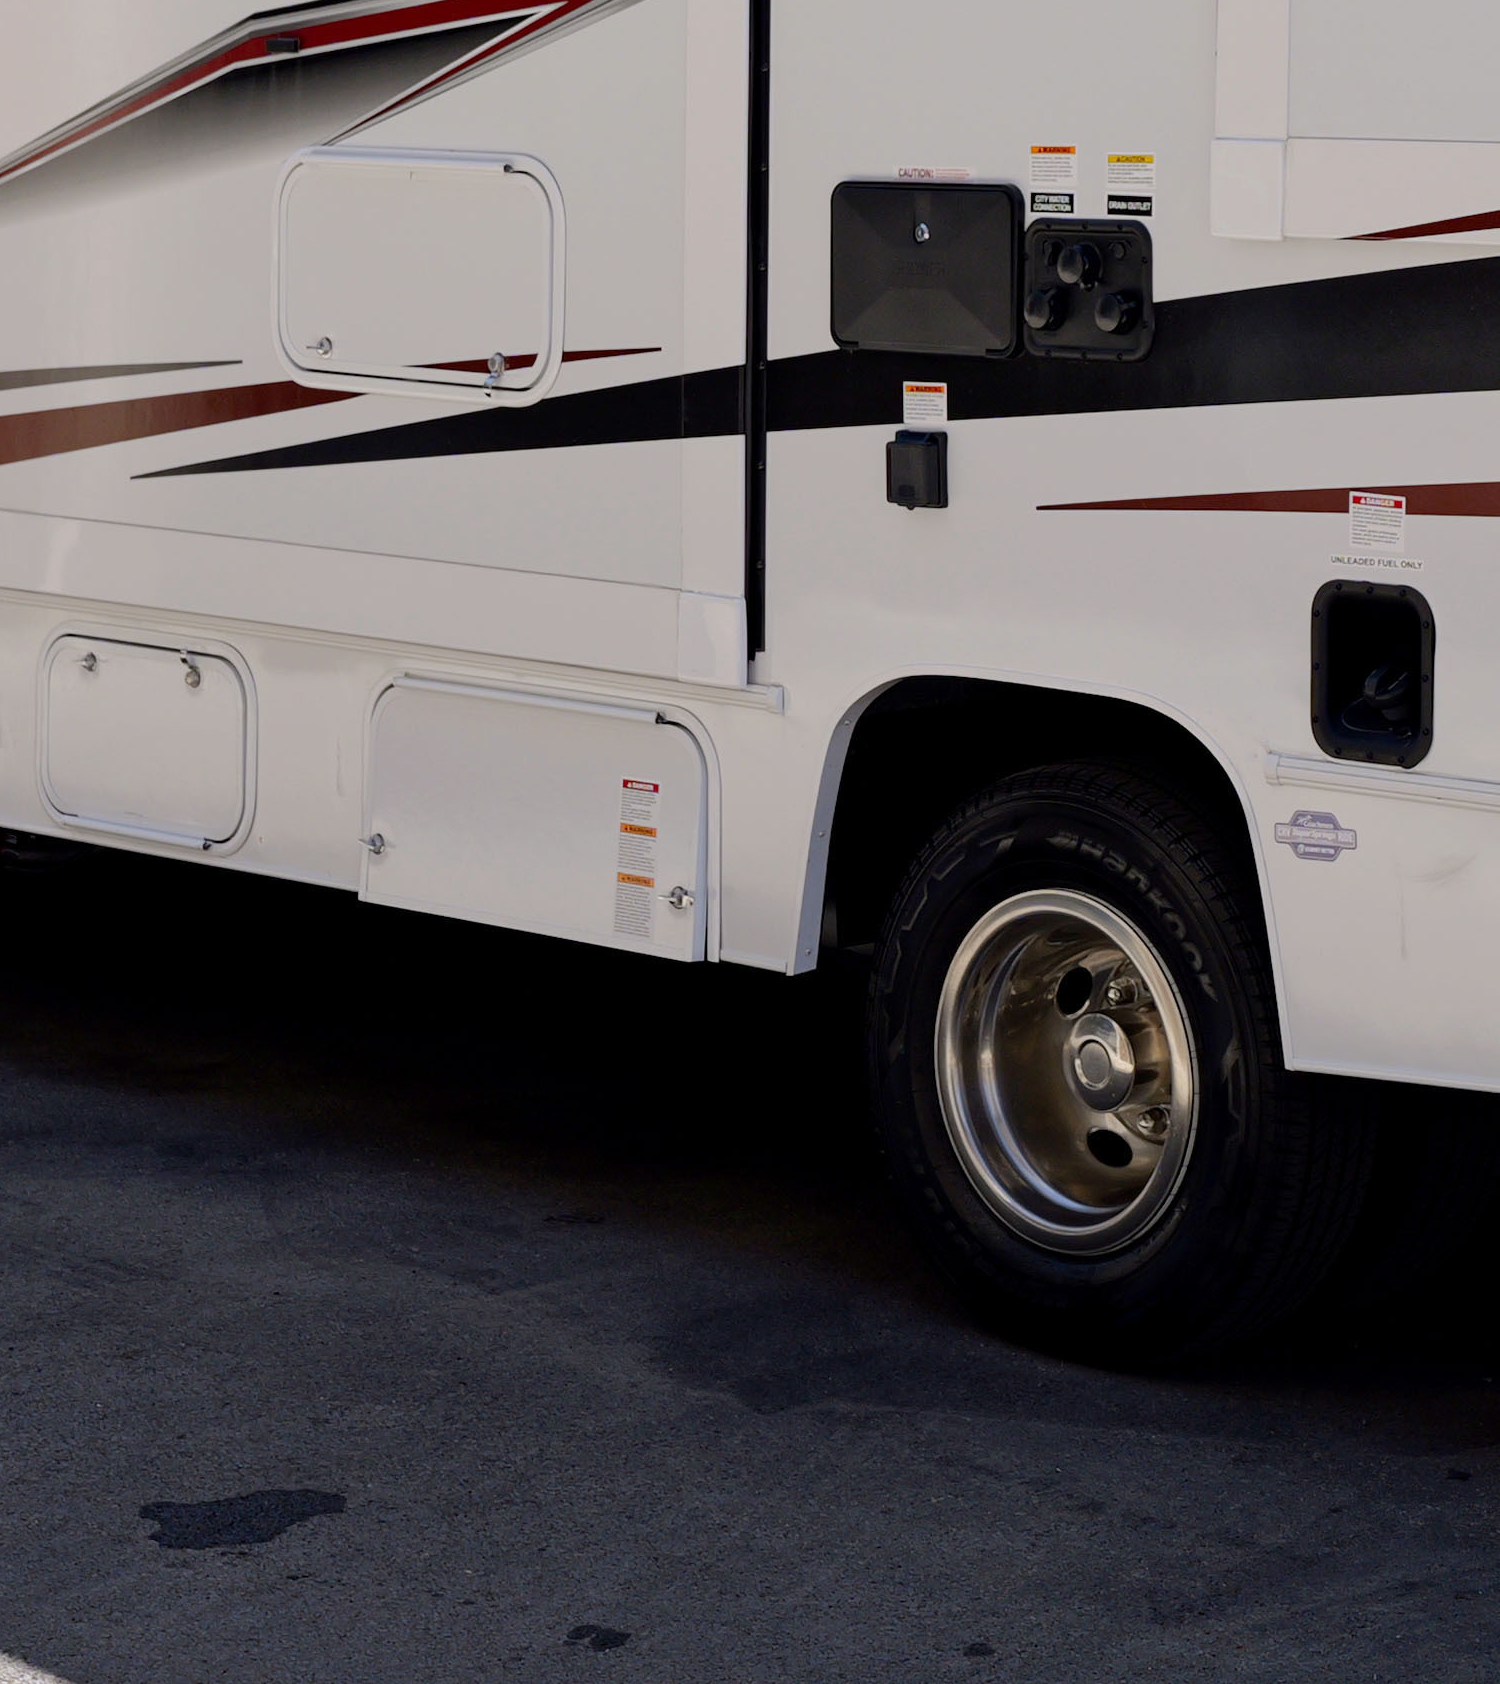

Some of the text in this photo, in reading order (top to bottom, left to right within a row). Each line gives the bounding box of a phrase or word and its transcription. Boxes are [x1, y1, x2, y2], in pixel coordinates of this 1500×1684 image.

[898, 167, 934, 179] CAUTION:
[1331, 556, 1423, 570] UNLEADED FUEL ONLY
